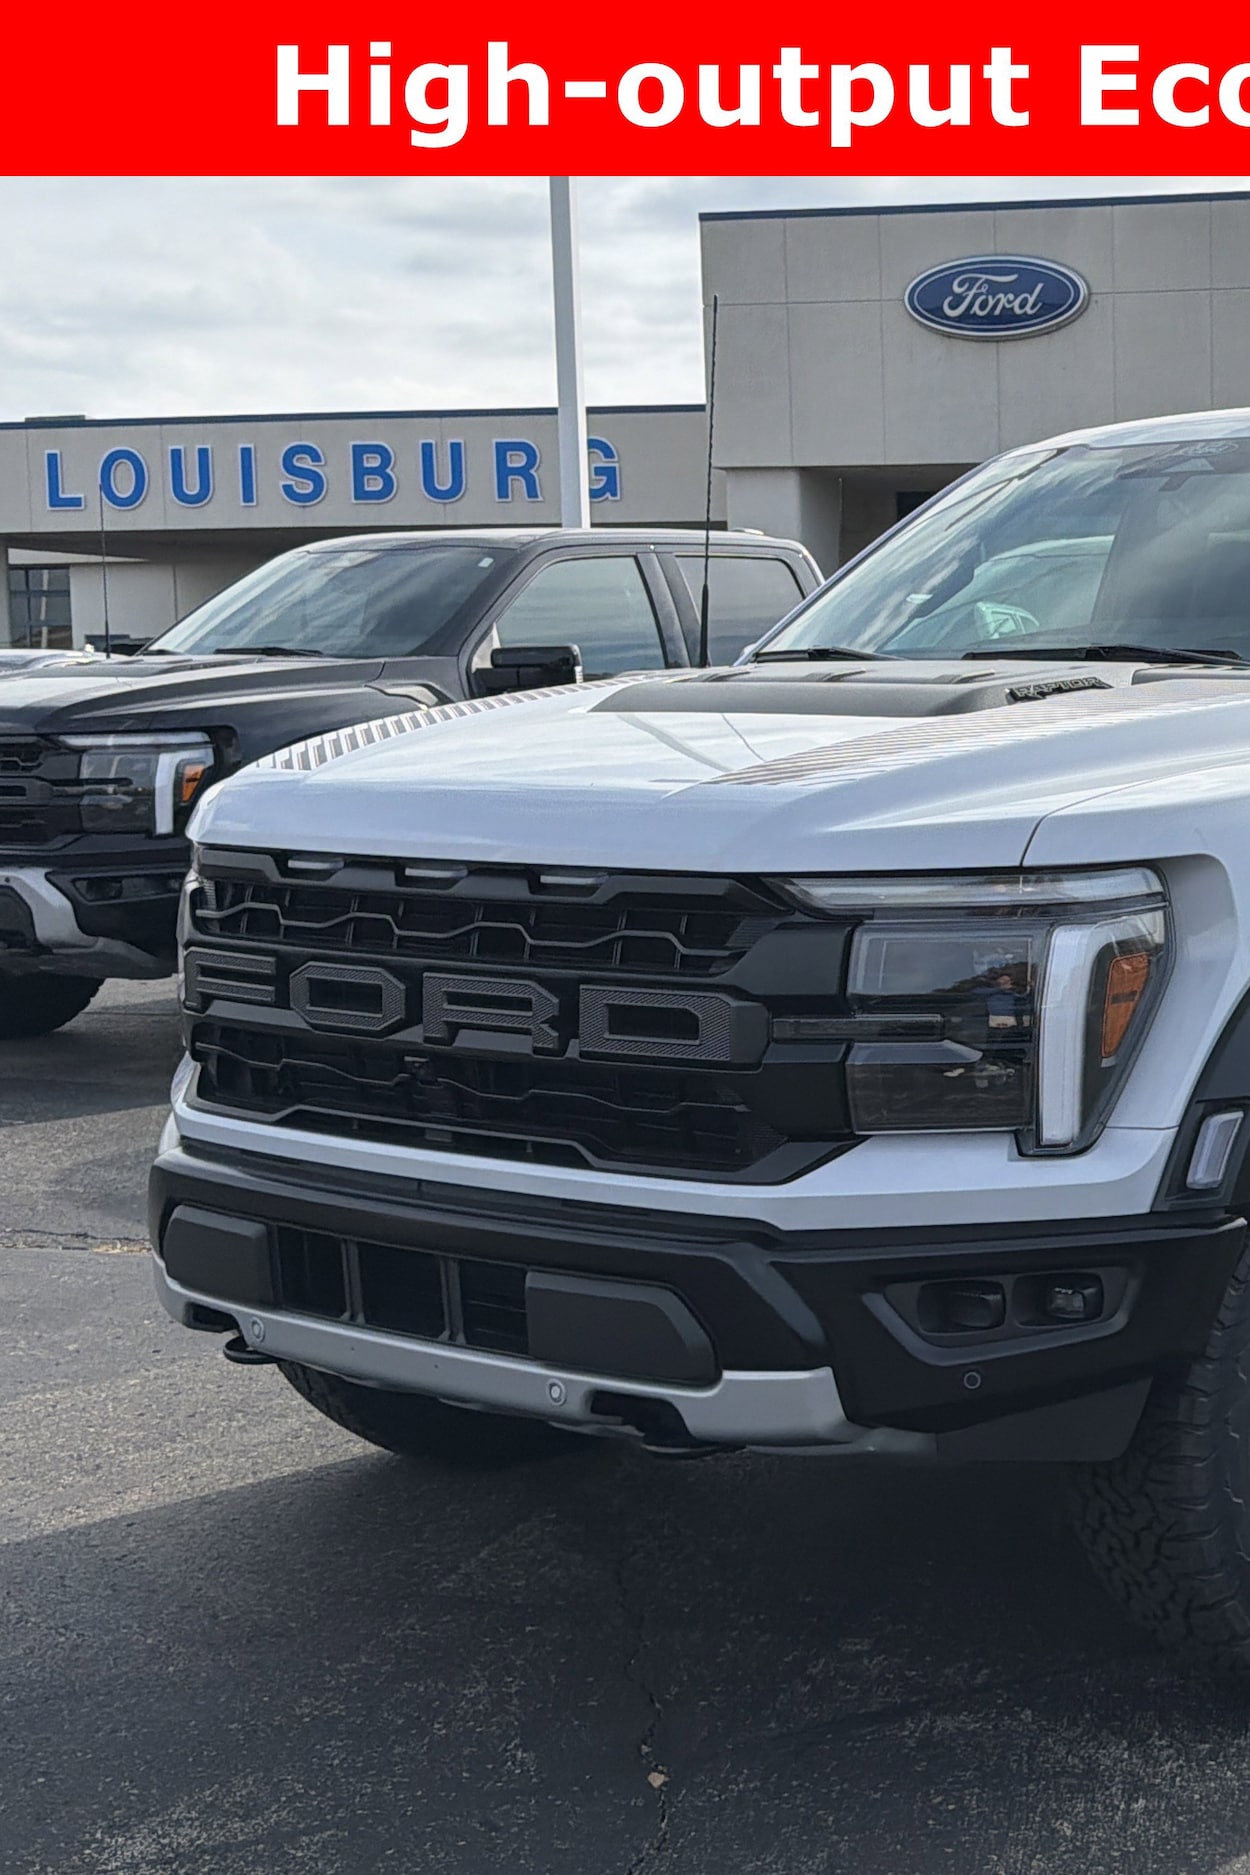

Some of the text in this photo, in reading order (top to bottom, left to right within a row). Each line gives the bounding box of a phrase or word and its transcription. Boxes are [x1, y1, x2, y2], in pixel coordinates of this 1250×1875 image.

[942, 272, 1045, 319] Ford
[44, 436, 622, 511] LOUISBURG
[1014, 677, 1099, 698] RAPTOR
[183, 946, 764, 1071] FORD
